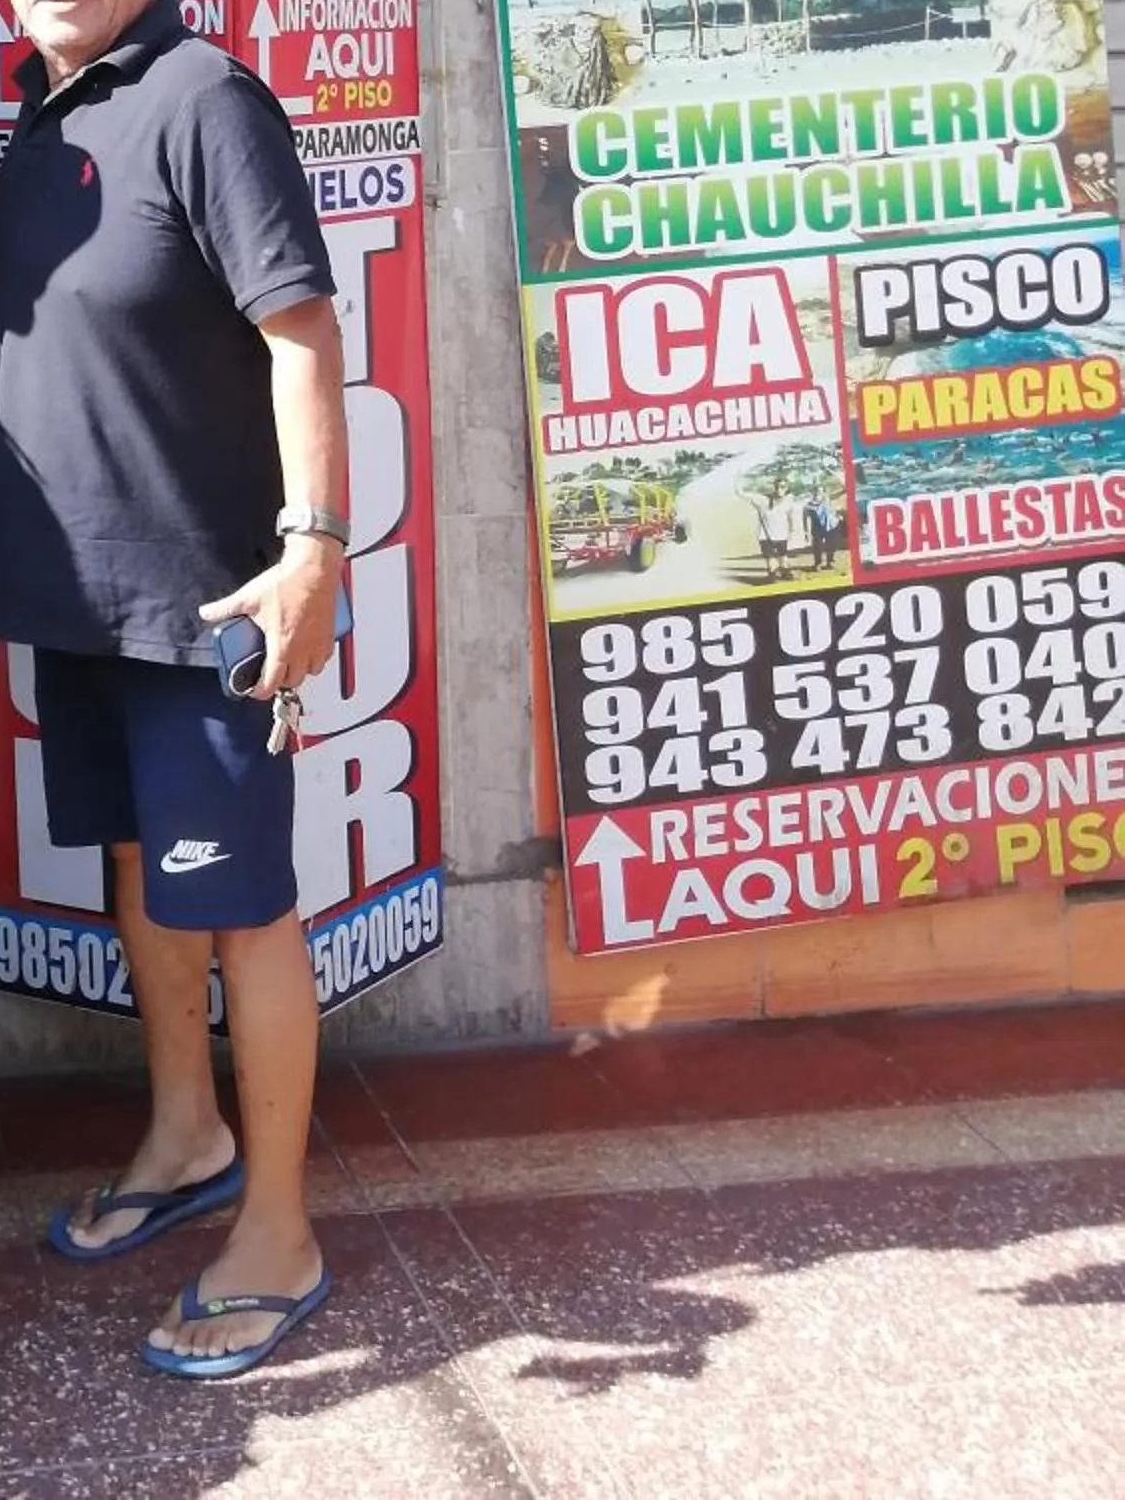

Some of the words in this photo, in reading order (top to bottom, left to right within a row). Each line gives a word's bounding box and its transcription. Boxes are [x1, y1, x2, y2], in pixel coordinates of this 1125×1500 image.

[305, 32, 394, 80] AQUI
[344, 80, 393, 111] PISO
[293, 119, 421, 160] PARAMONGA
[576, 72, 1060, 177] CEMENTERIO
[307, 163, 406, 212] ELOS
[580, 148, 1065, 254] CHAUCHILLA
[564, 275, 803, 403] ICA
[860, 247, 1105, 343] PISCO
[547, 391, 826, 453] HUACACHINA
[863, 361, 1117, 436] PARACAS
[875, 469, 1125, 556] BALLESTAS
[580, 608, 755, 682] 985
[777, 585, 945, 658] 020
[966, 561, 1125, 633] 059
[581, 671, 748, 746] 941
[772, 648, 942, 720] 537
[964, 622, 1125, 694] 040
[584, 728, 768, 803] 943
[791, 703, 953, 774] 473
[977, 680, 1125, 751] 842
[170, 839, 220, 860] NIKE
[650, 749, 1125, 863] RESERVACIONE
[655, 849, 880, 934] AQUI
[306, 877, 439, 1003] 5020059
